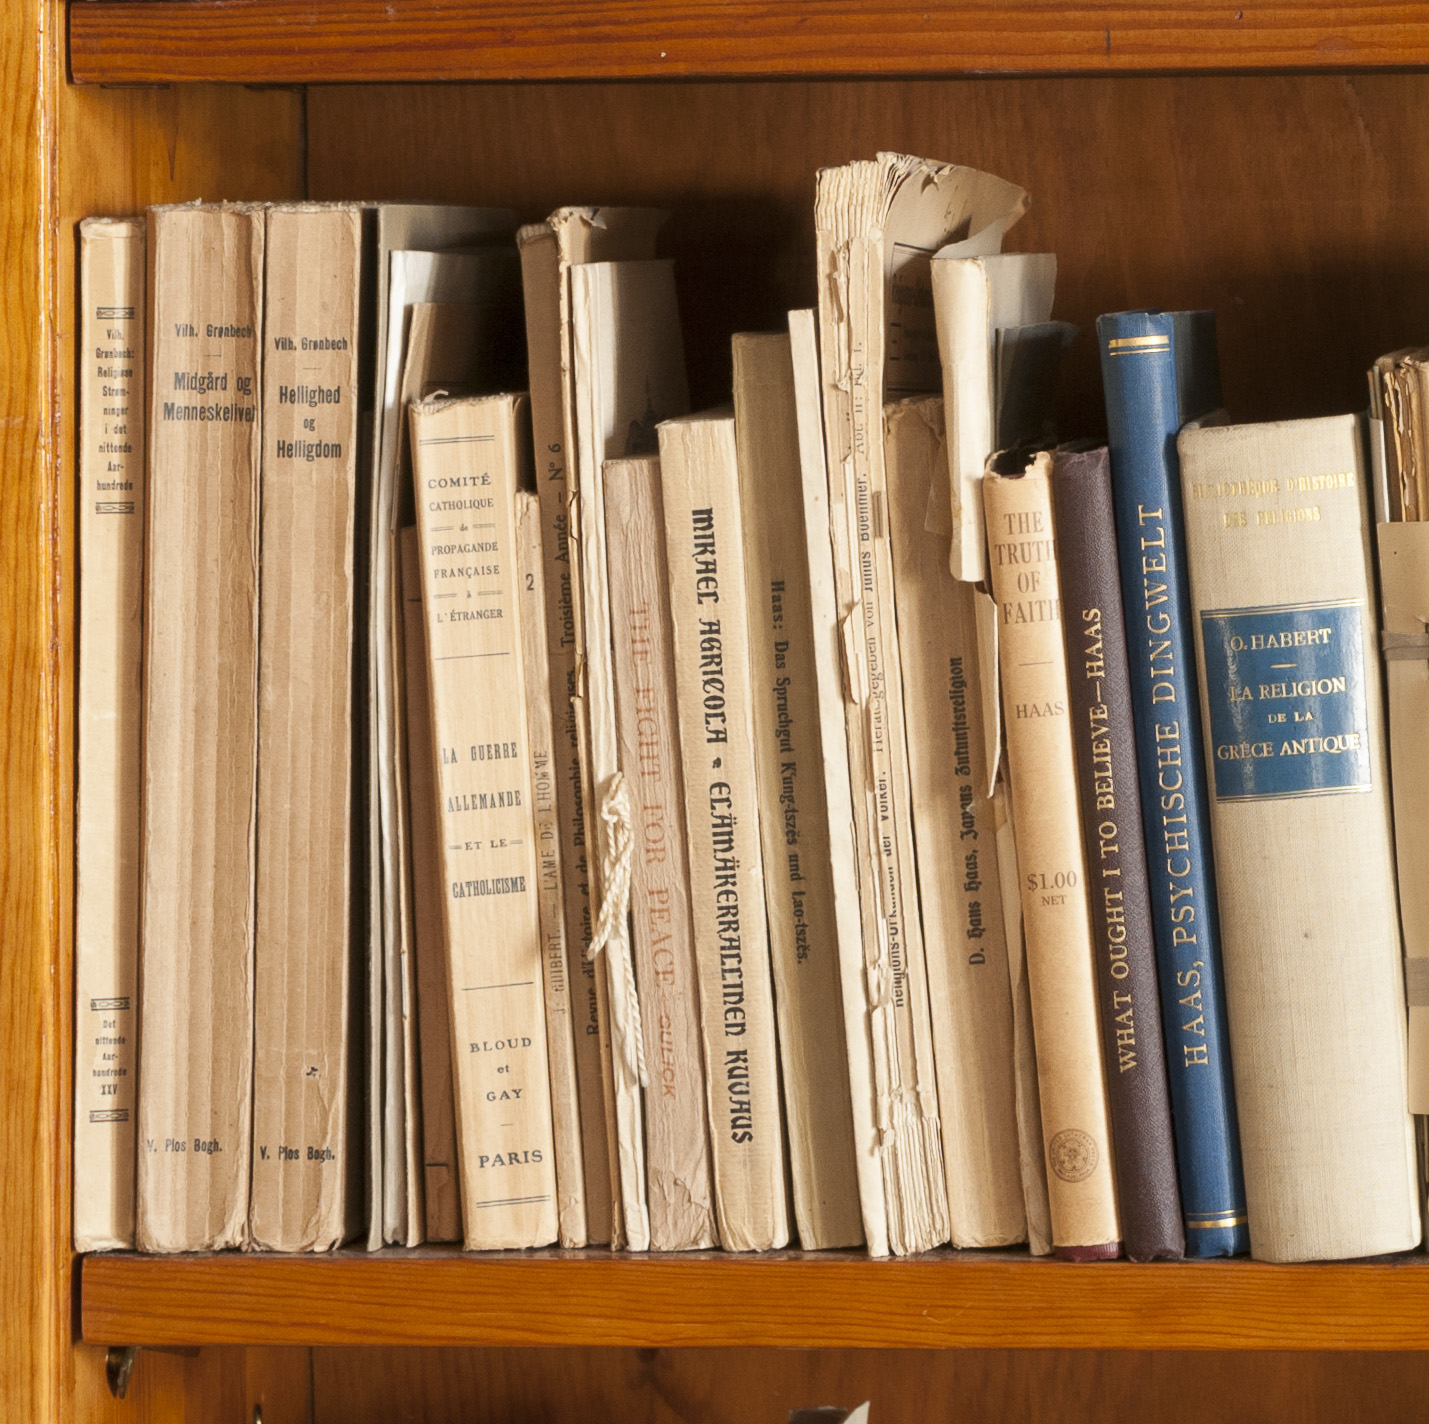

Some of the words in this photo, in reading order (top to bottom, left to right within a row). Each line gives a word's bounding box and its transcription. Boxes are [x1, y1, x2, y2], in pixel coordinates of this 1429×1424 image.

[301, 337, 348, 351] Grønbech
[173, 371, 228, 393] Midgård
[237, 375, 252, 393] og
[279, 386, 341, 405] Hellighed
[163, 403, 257, 423] Menneskelivet
[303, 417, 315, 430] og
[276, 440, 342, 460] Helligdom
[428, 474, 491, 489] COMITÉ
[430, 497, 494, 512] CATHOLIQUE
[431, 541, 498, 556] PROPAGANDE
[433, 564, 500, 580] FRANÇAISE
[1138, 504, 1176, 703] DINGWELT
[1251, 629, 1331, 649] HABERT
[1230, 683, 1253, 700] LA
[1259, 677, 1345, 699] RELIGION
[1016, 702, 1064, 720] HAAS
[471, 742, 517, 761] GUERRE
[1217, 740, 1273, 760] GRÈCE
[1280, 733, 1360, 756] ANTIQUE
[448, 790, 522, 812] ALLEMANDE
[1100, 821, 1118, 859] TO
[1155, 721, 1197, 946] PSYCHISCHE
[452, 876, 526, 899] CATHOLICISME
[1027, 871, 1077, 891] $1.00
[1042, 895, 1067, 906] NET
[1103, 890, 1128, 979] OUGHT
[1176, 961, 1209, 1068] HAAS,
[1114, 992, 1137, 1073] WHAT
[470, 1037, 533, 1053] BLOUD
[486, 1089, 523, 1102] GAY
[479, 1149, 543, 1169] PARIS
